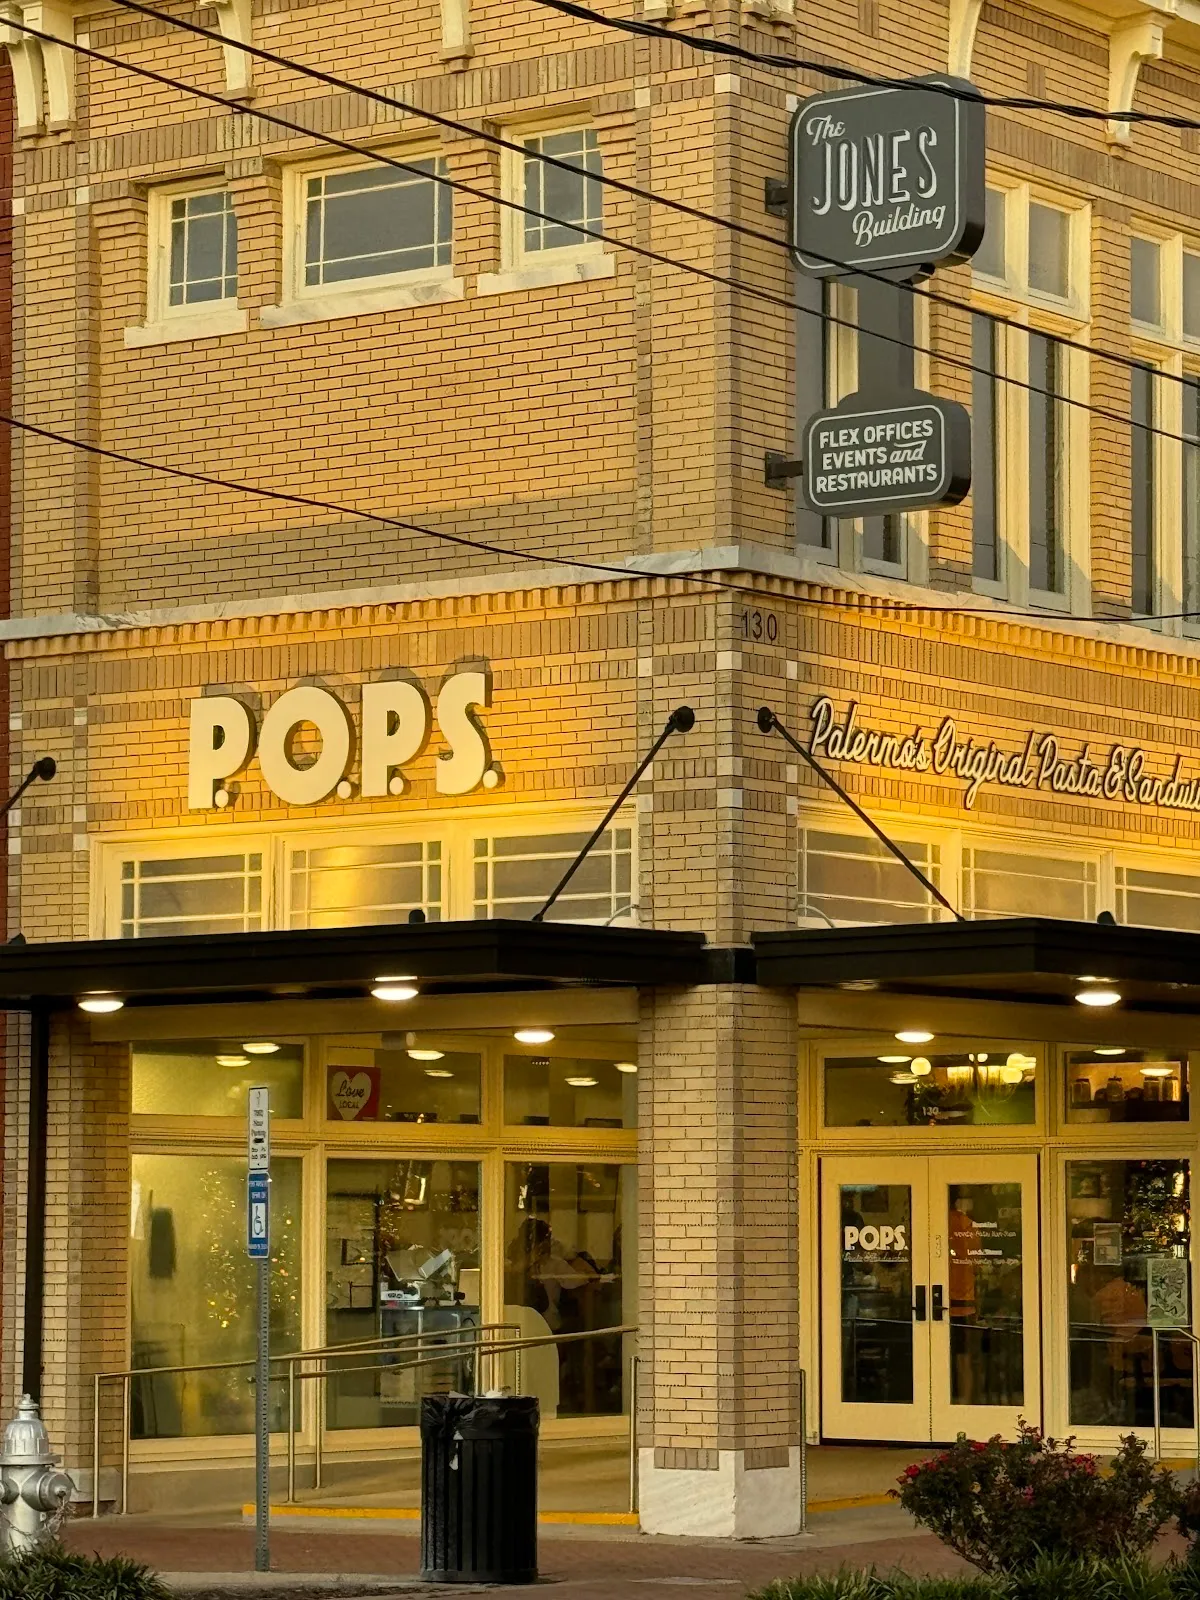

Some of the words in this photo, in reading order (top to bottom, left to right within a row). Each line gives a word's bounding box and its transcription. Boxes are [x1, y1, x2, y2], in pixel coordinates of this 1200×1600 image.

[806, 115, 845, 146] The
[811, 125, 937, 215] JONES
[852, 202, 946, 247] Building
[819, 427, 860, 449] FLEX
[863, 419, 934, 444] OFFICES
[822, 446, 888, 471] EVENTS
[889, 440, 927, 463] and
[816, 464, 938, 494] RESTAURANTS
[741, 610, 777, 641] 130
[809, 697, 931, 772] Palermo's
[933, 716, 1035, 810] Original
[1037, 734, 1102, 796] Pasta
[1103, 745, 1127, 799] &
[1124, 748, 1200, 811] Sandwi
[335, 1079, 366, 1098] Love
